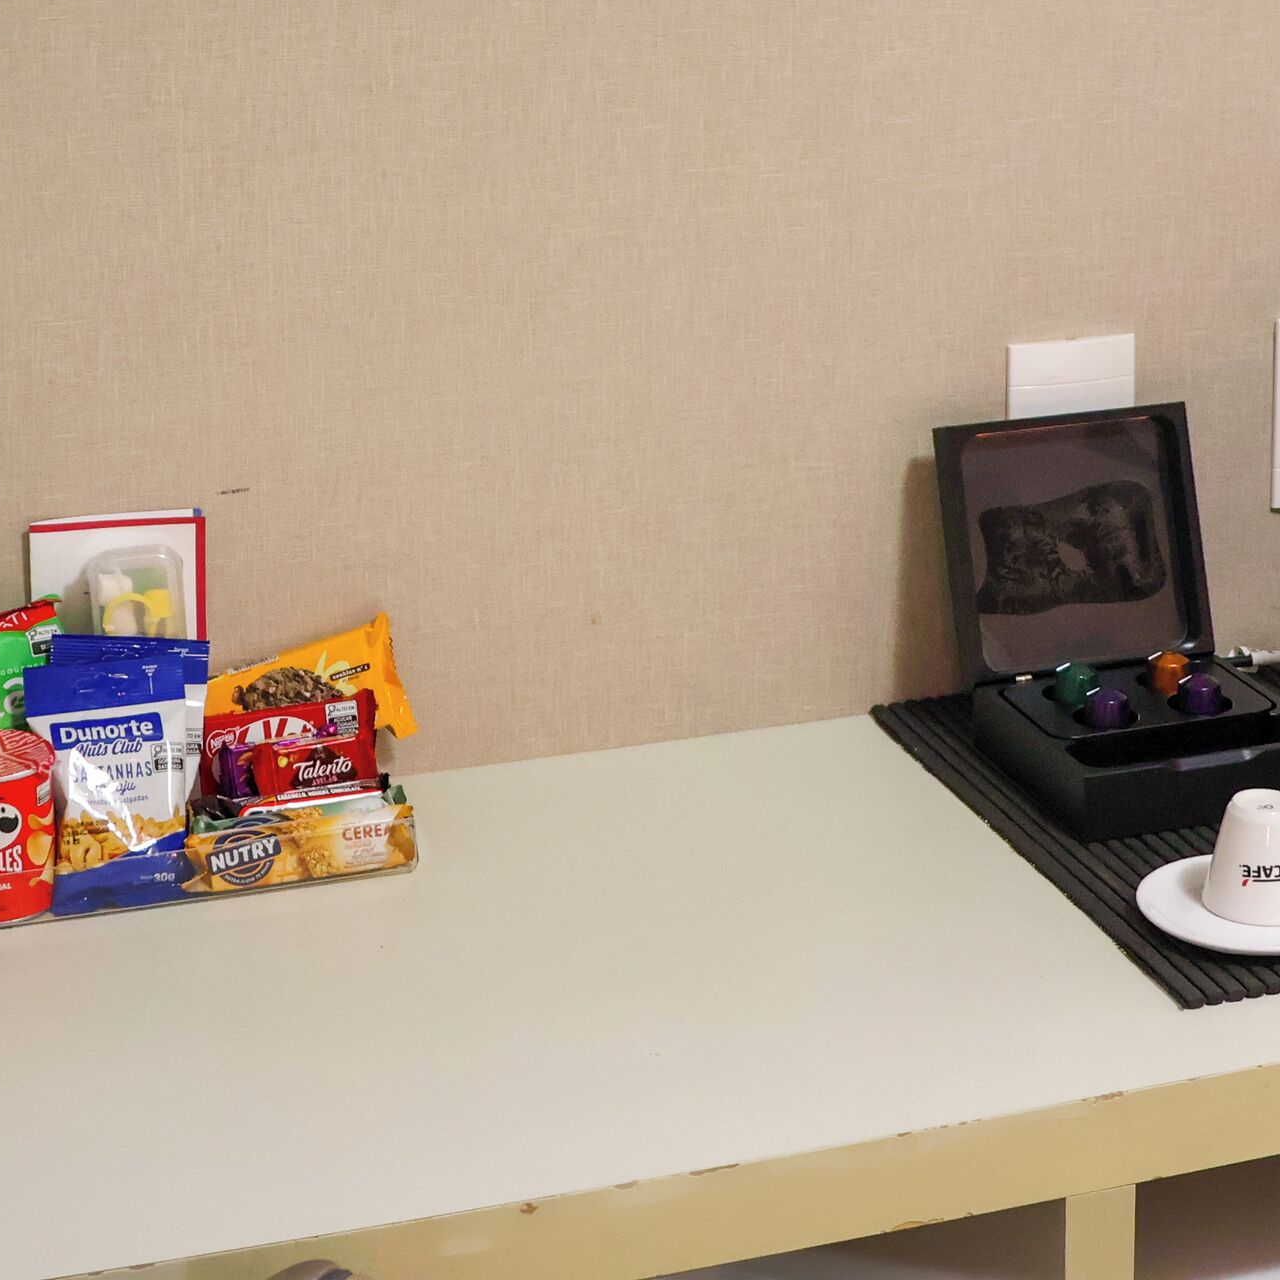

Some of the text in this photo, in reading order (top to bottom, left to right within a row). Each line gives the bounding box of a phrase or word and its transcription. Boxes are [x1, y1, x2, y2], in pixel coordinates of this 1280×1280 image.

[59, 719, 154, 744] Dunorte
[76, 738, 143, 758] Nuts Club
[293, 756, 352, 782] Talento
[210, 836, 275, 872] NUTRY
